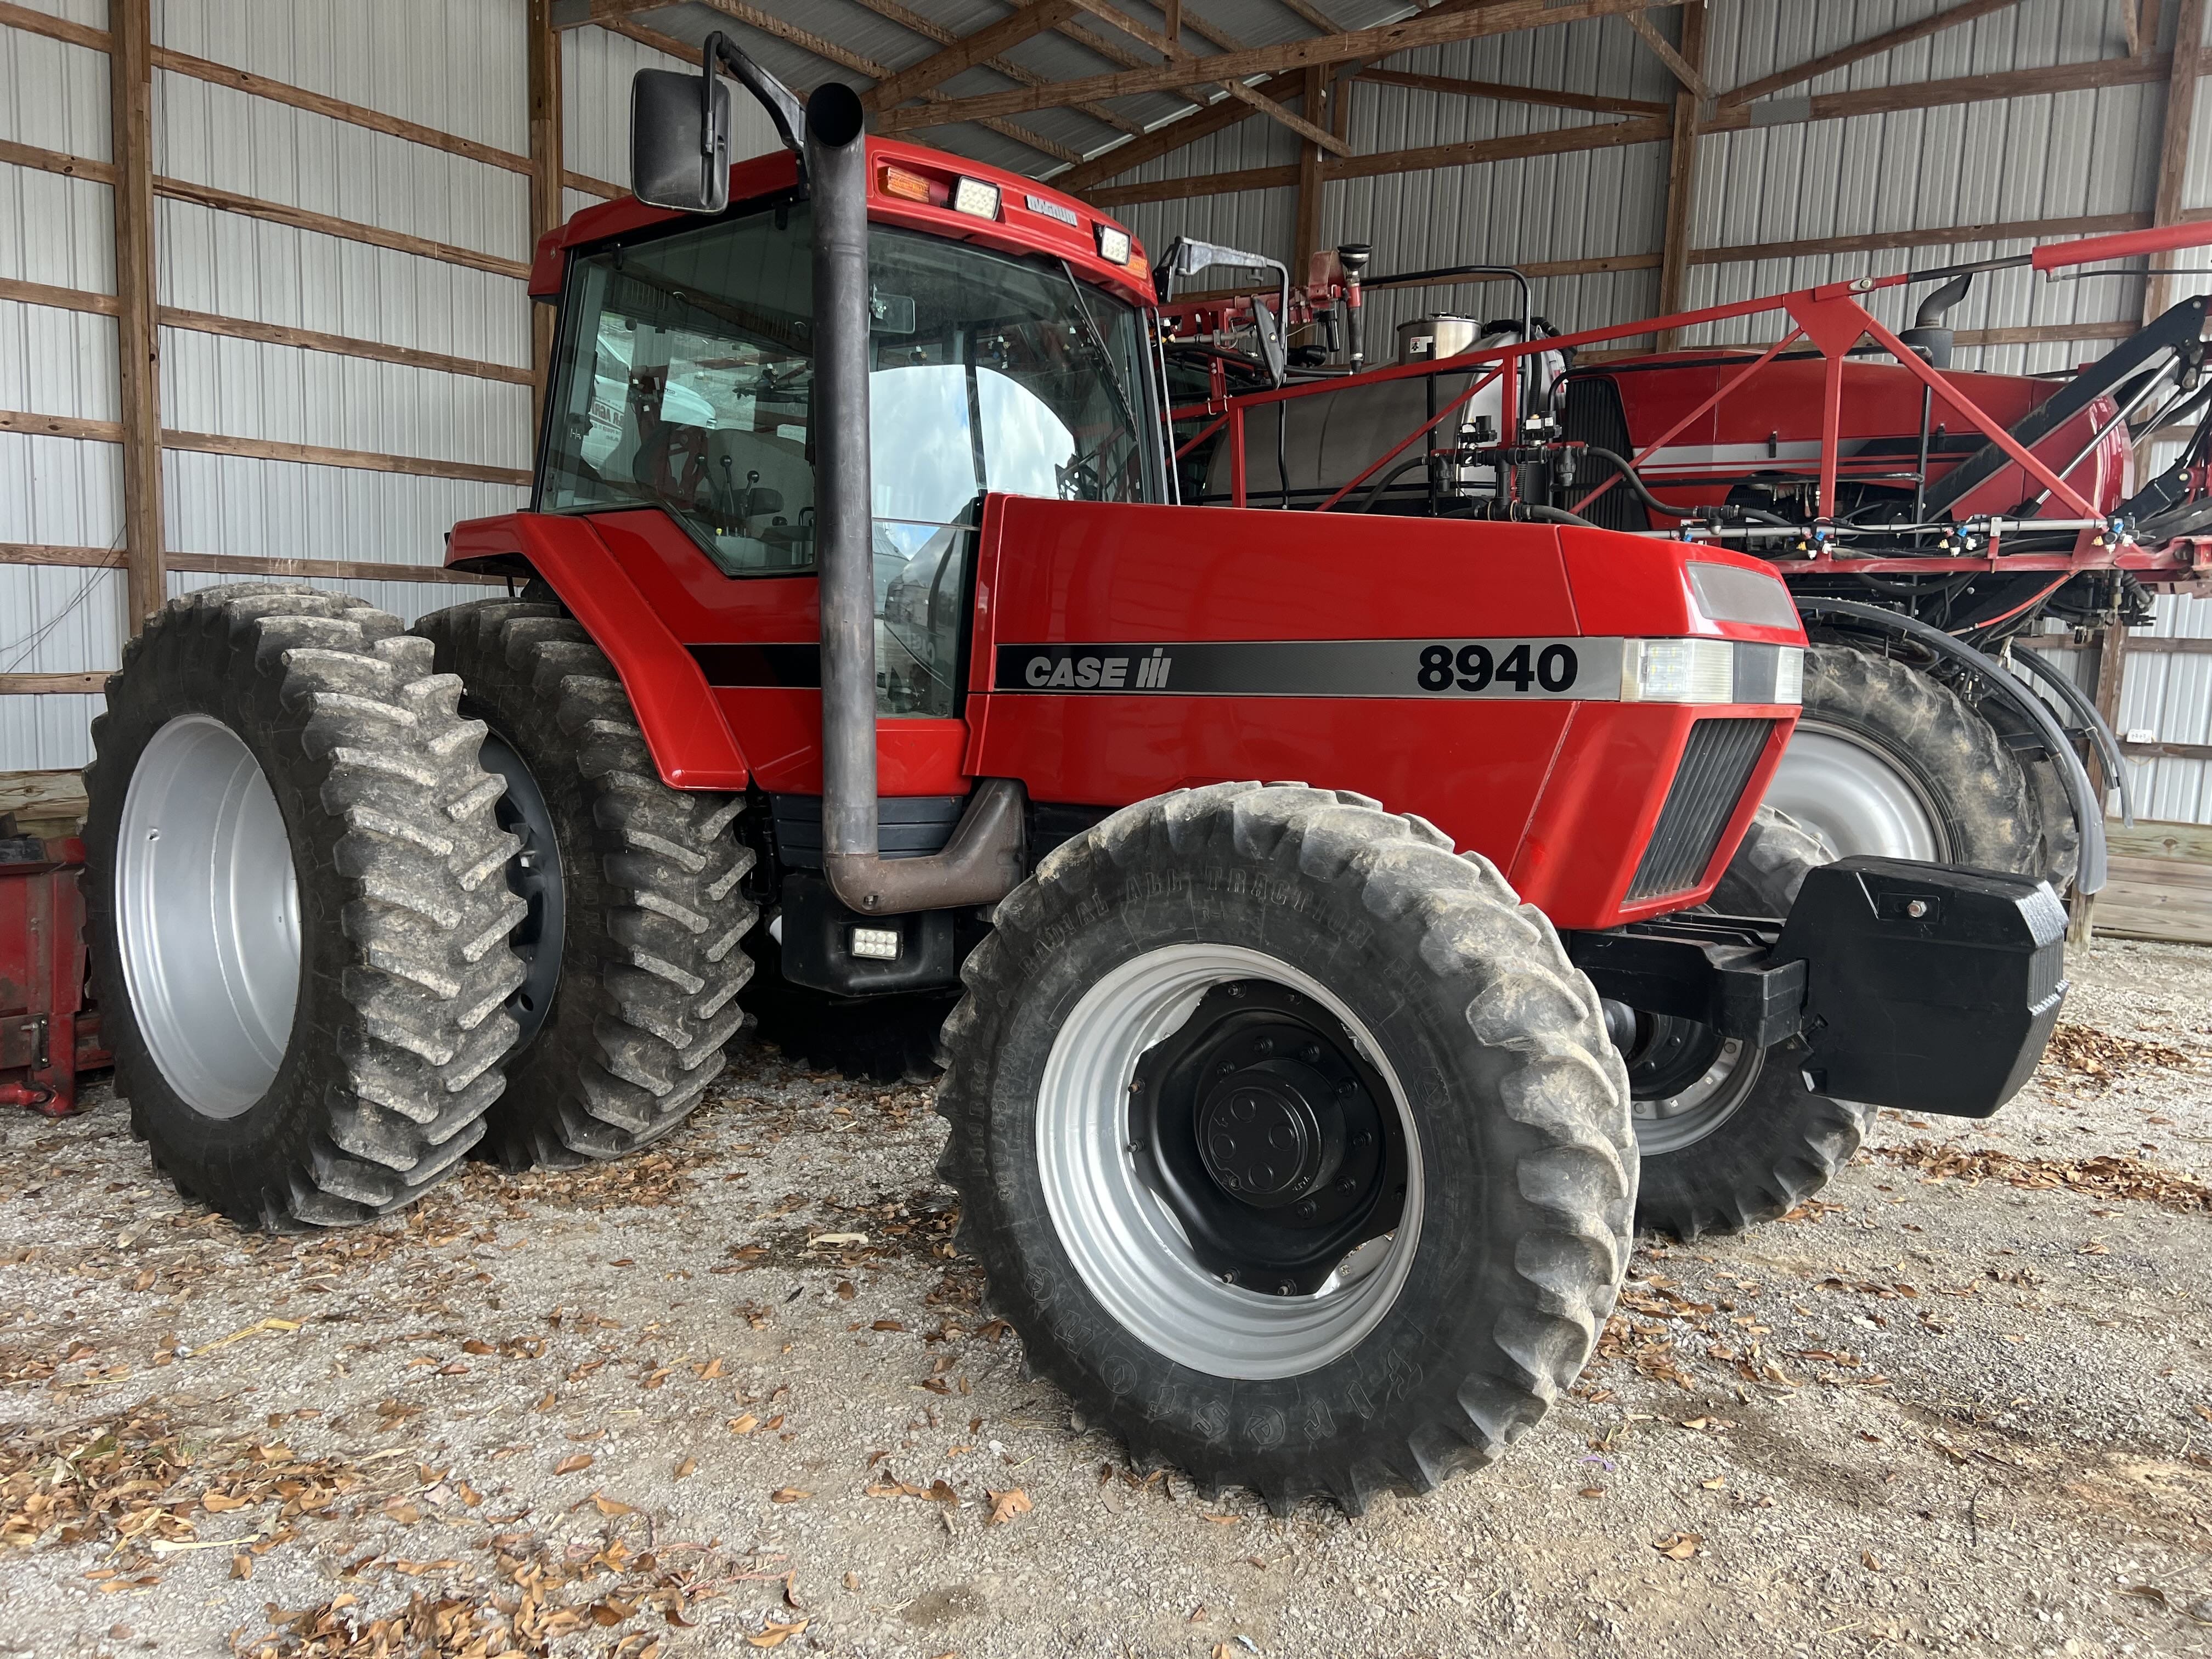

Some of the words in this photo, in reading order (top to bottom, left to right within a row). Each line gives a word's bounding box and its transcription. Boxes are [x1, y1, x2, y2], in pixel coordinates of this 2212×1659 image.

[1026, 195, 1077, 226] MAGNUM
[1025, 656, 1128, 688] CASE
[1417, 644, 1577, 692] 8940
[1018, 890, 1110, 980] RADIAL
[1125, 867, 1183, 904] ALL
[1204, 866, 1375, 950] TRACTION
[1383, 955, 1446, 1024] FWD
[1025, 1267, 1424, 1447] Firestone
